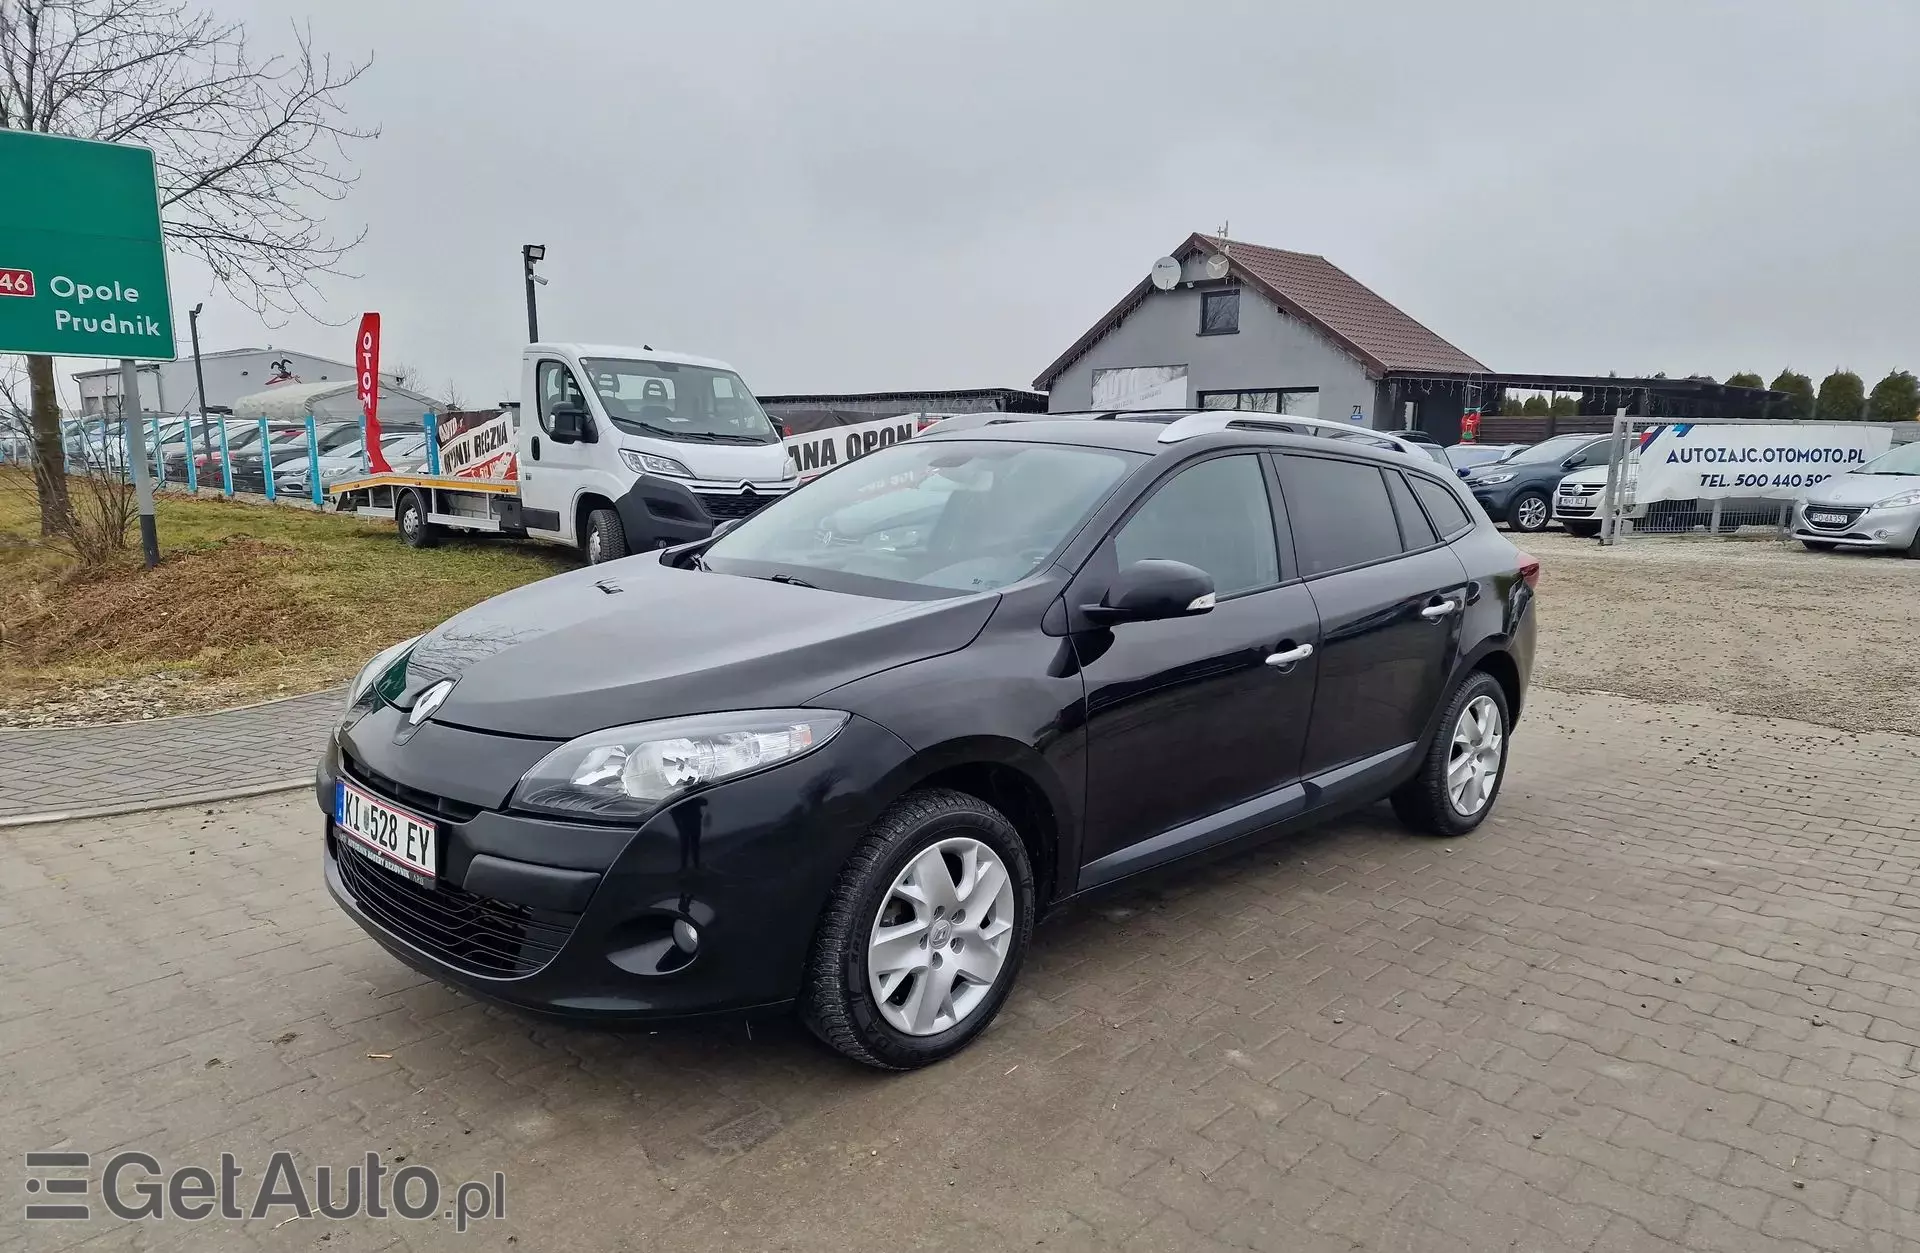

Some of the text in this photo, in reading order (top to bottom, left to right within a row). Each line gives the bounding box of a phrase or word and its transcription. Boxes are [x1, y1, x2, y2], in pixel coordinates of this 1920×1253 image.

[0, 273, 28, 292] 46
[49, 275, 139, 304] Opole
[55, 309, 161, 336] Prudnik
[1352, 405, 1362, 415] 71
[845, 423, 913, 461] OPON
[1666, 447, 1866, 464] AUTOZAJC.OTOMOTO.PL
[1699, 474, 1832, 488] TEL. 500 440 59
[345, 790, 360, 832] KI
[370, 804, 398, 851] 528
[406, 821, 430, 866] EY
